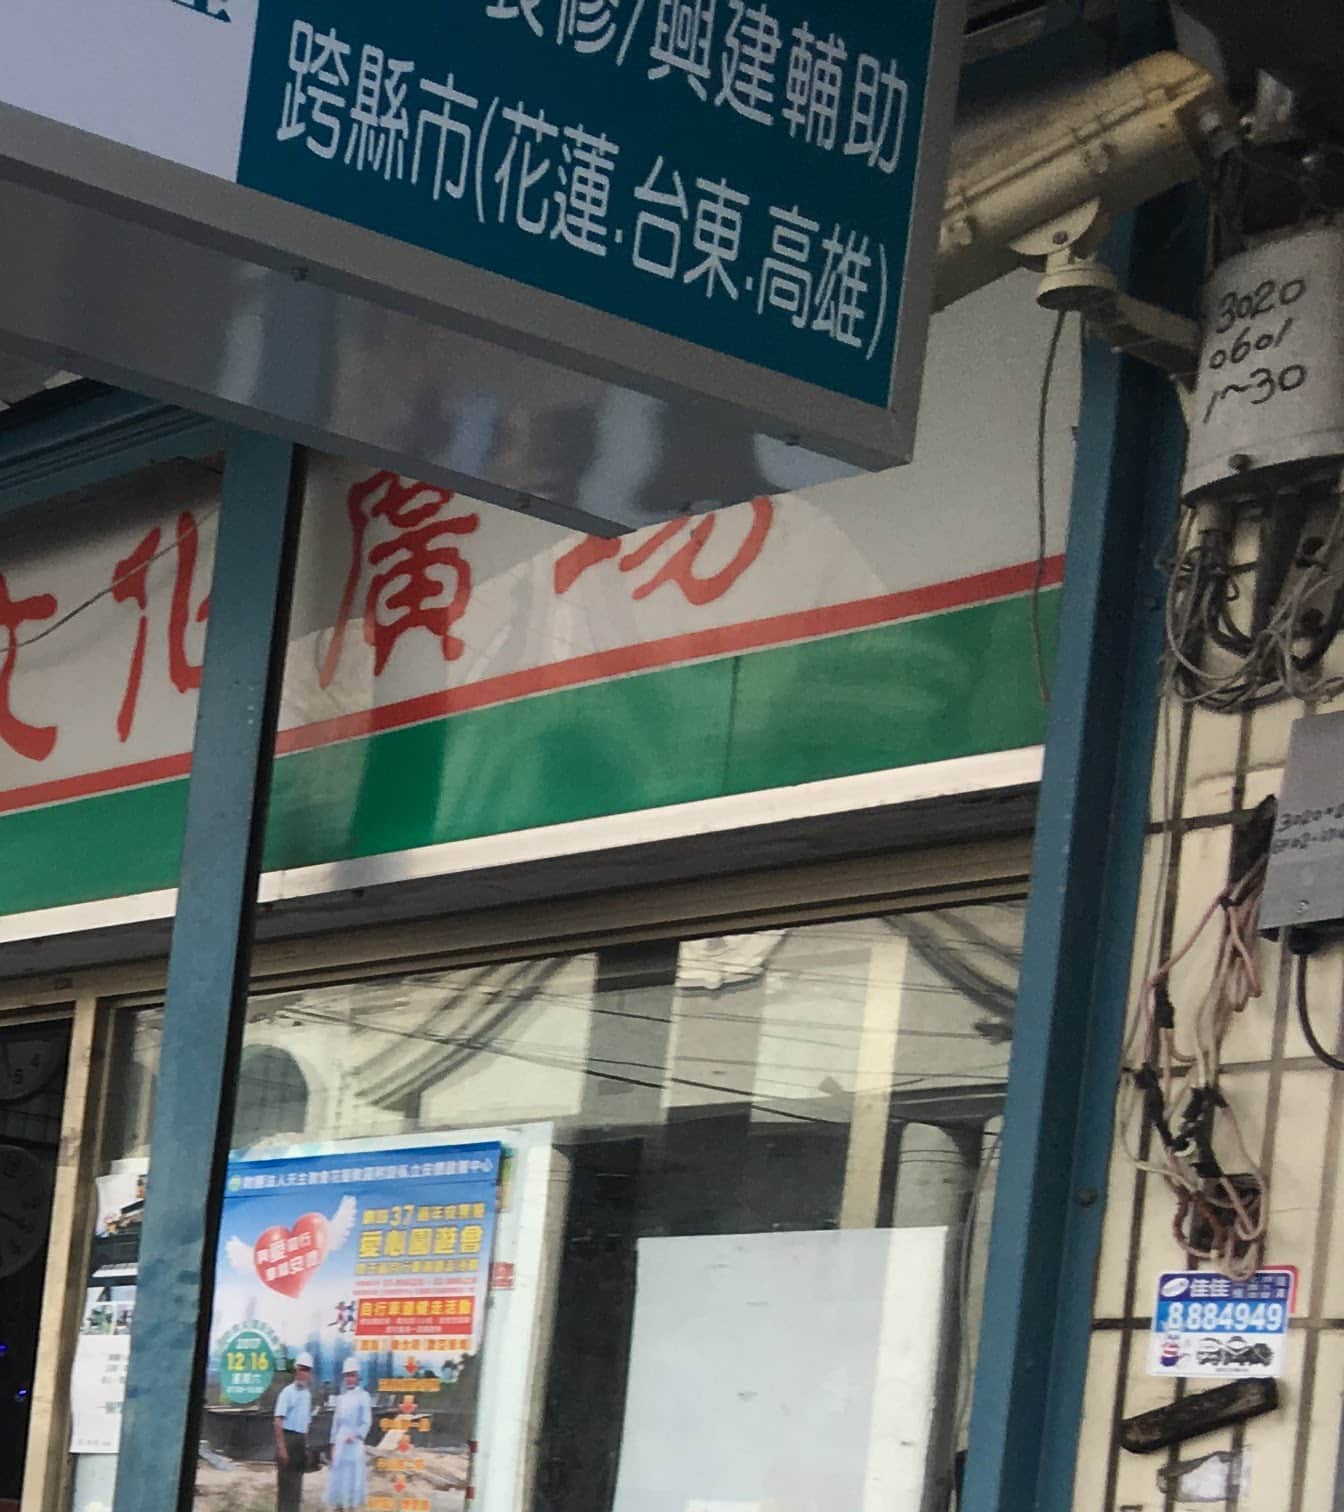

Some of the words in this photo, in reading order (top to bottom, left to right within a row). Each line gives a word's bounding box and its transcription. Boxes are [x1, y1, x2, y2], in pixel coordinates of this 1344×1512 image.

[1216, 278, 1307, 334] 3020
[1209, 318, 1294, 371] 0601
[1167, 1302, 1284, 1332] 8884949
